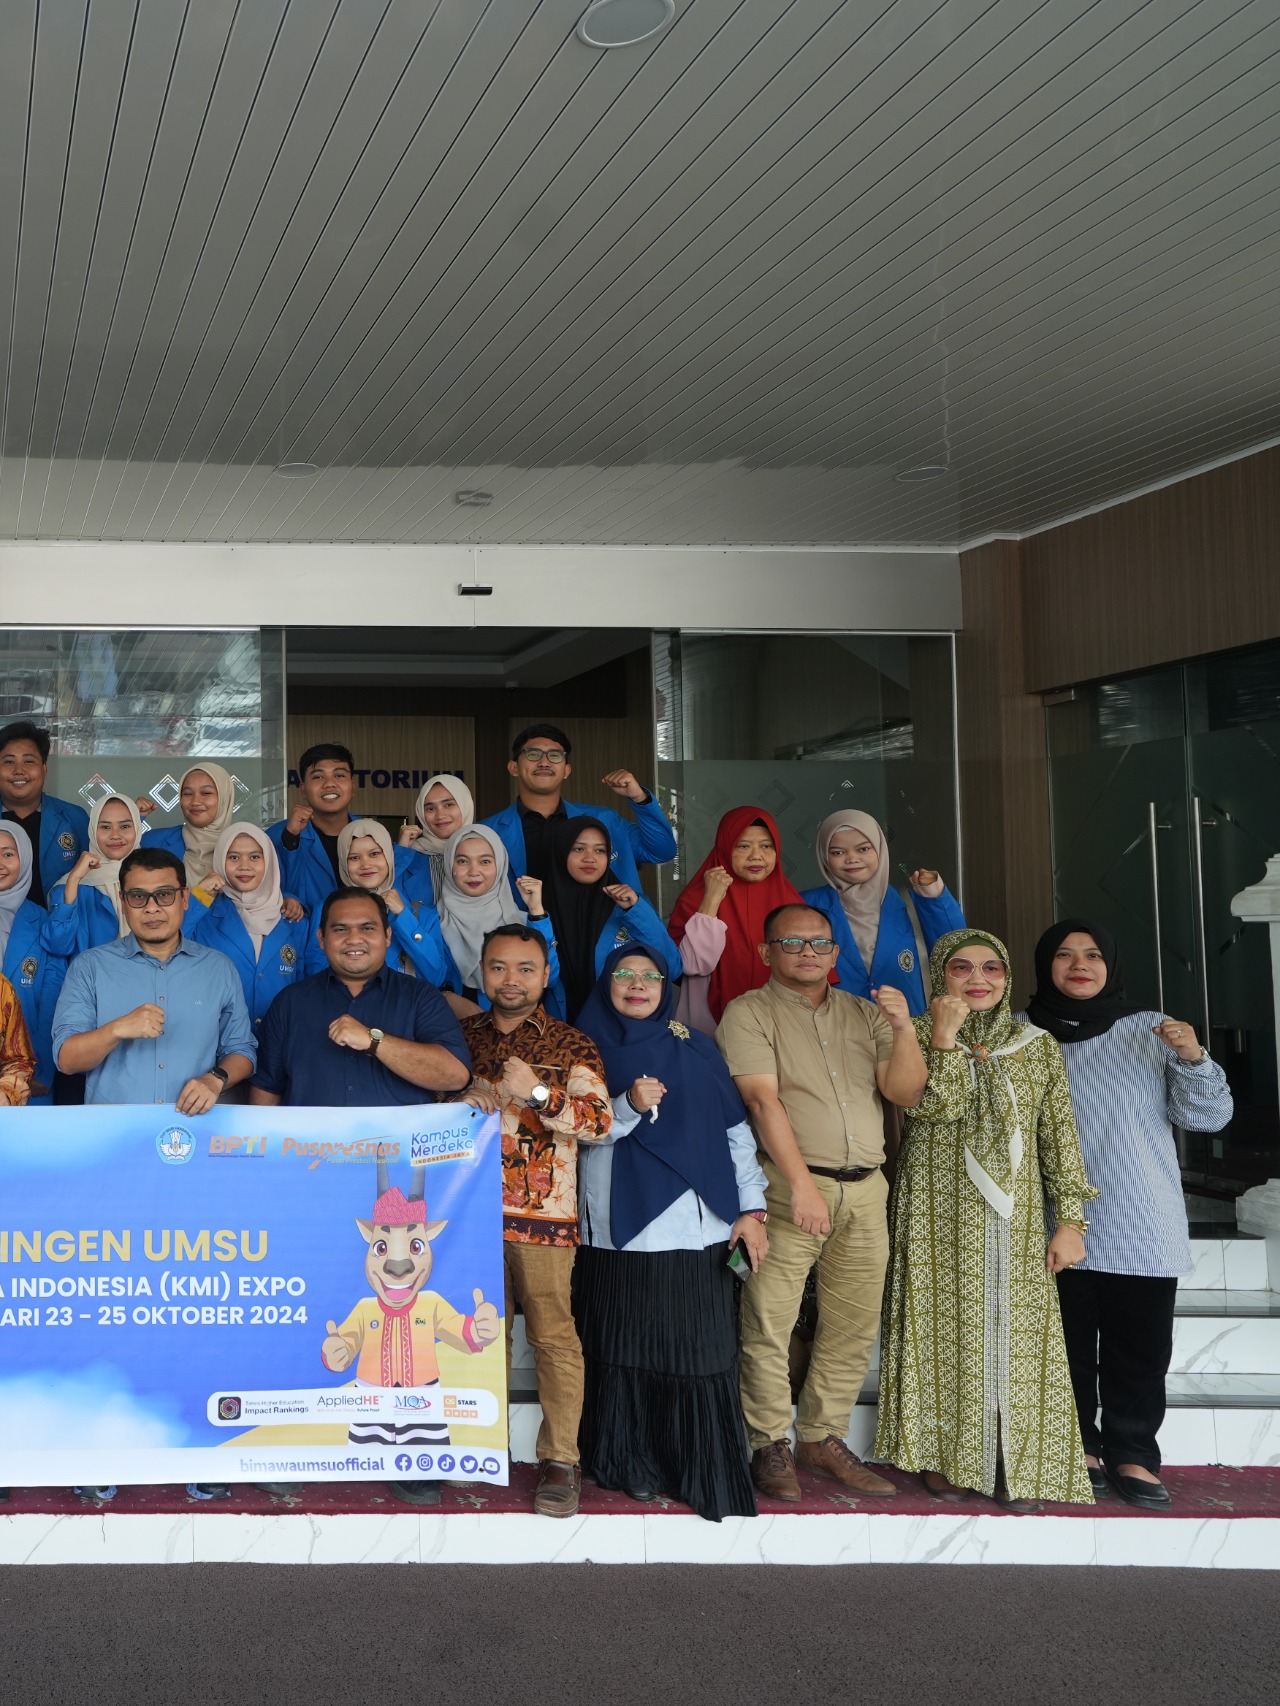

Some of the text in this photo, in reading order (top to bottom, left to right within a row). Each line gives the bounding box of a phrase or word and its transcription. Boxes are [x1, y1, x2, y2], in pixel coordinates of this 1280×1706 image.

[288, 769, 464, 789] ATORI
[209, 1136, 267, 1154] BPTI
[412, 1127, 469, 1145] Kampus
[411, 1139, 473, 1158] Merdeka
[415, 1156, 450, 1164] INDONESIA
[144, 1230, 268, 1262] UMSU
[12, 1276, 152, 1298] INDONESIA
[160, 1271, 231, 1302] (KMI)
[238, 1276, 306, 1297] EXPO
[46, 1307, 73, 1326] 23
[98, 1306, 126, 1325] 25
[132, 1306, 244, 1325] OKTOBER
[250, 1305, 308, 1324] 2024
[395, 1396, 428, 1408] MQA
[240, 1458, 384, 1472] bimawaumsuofficial
